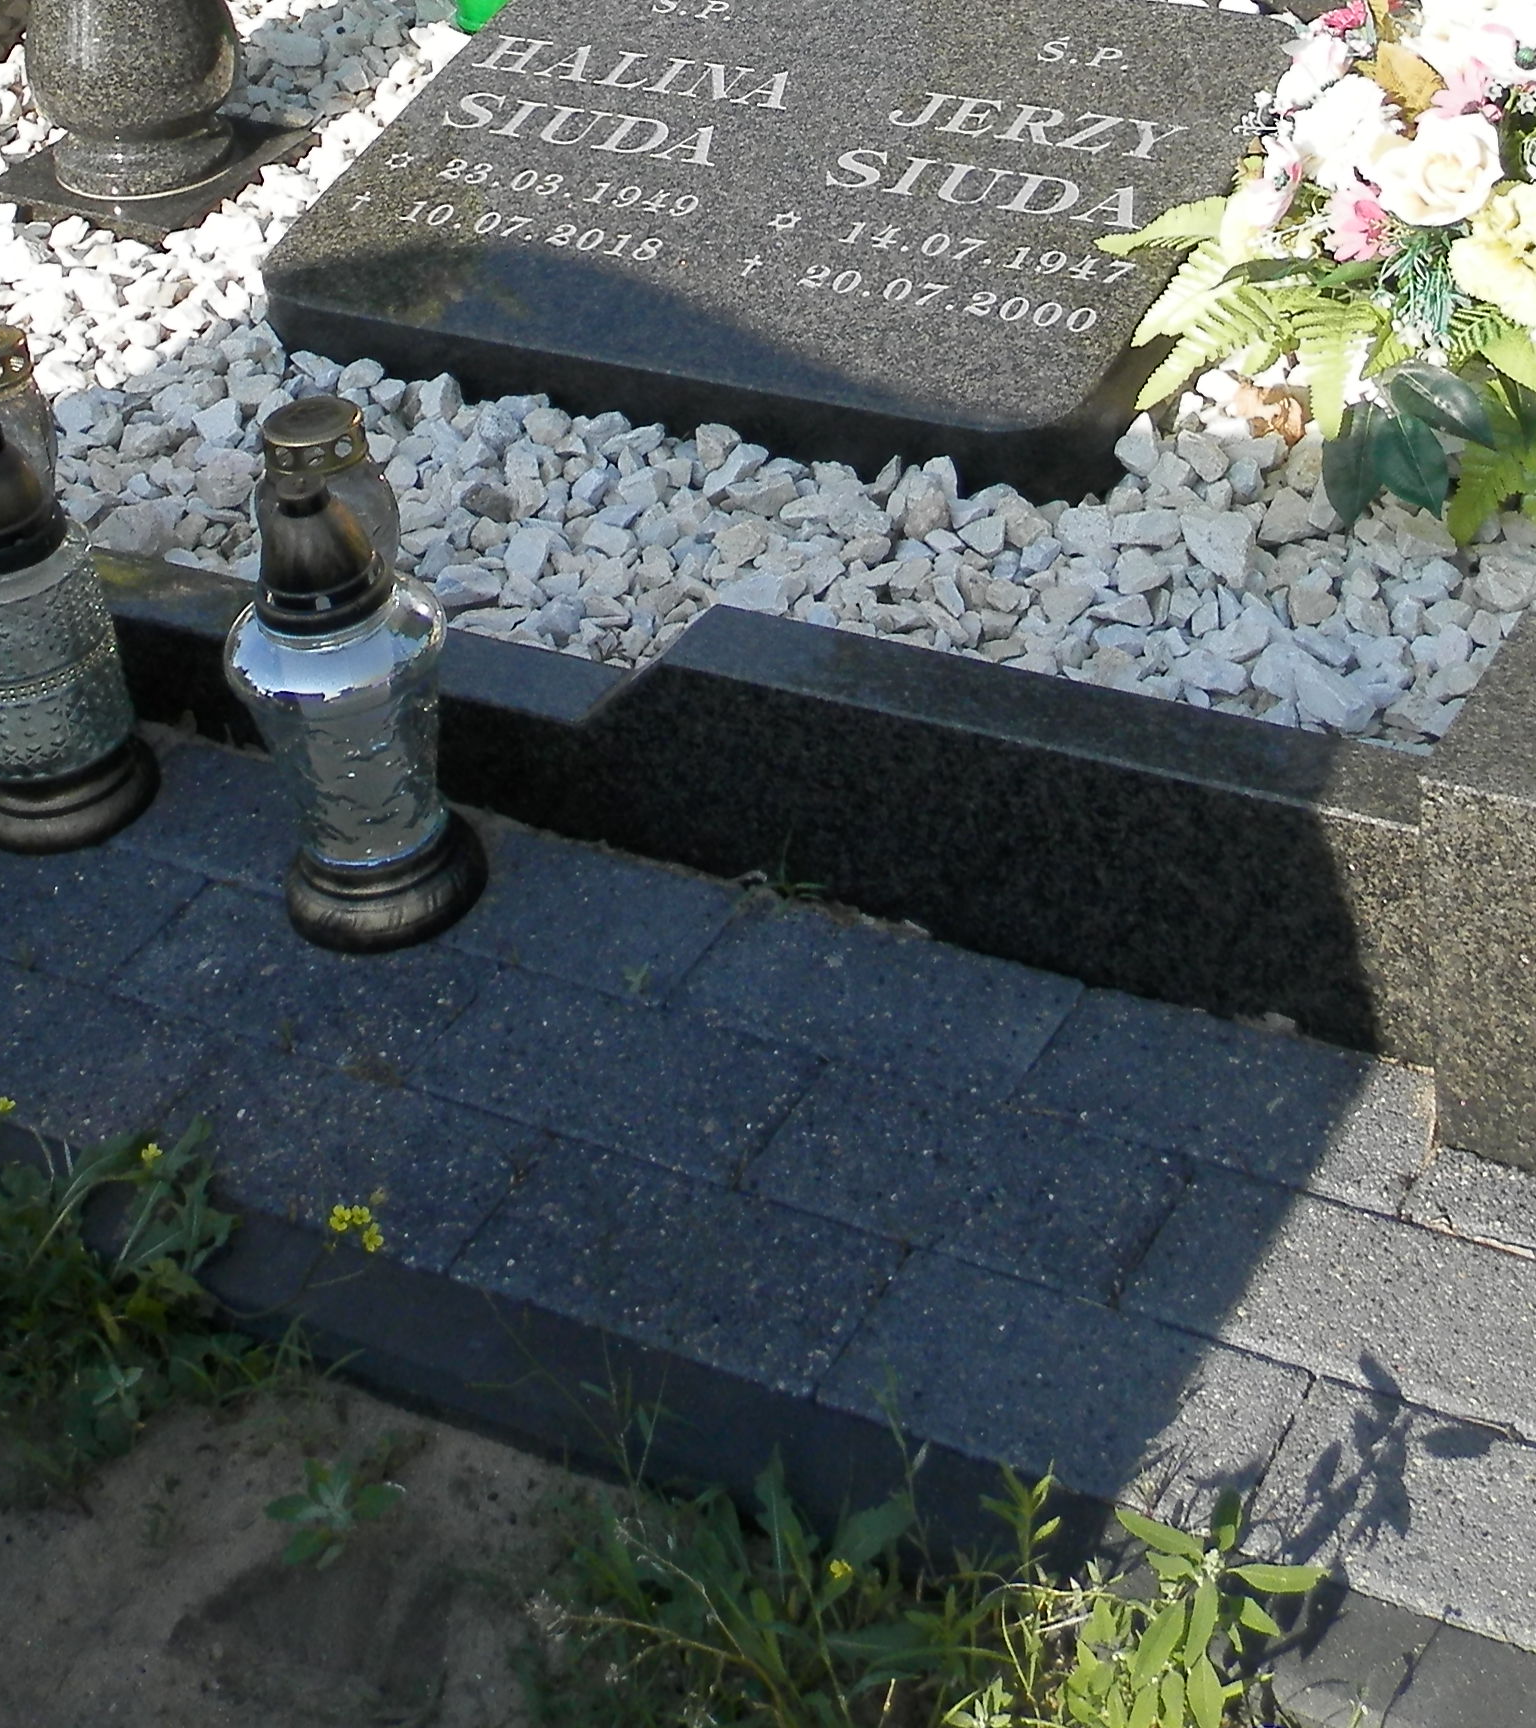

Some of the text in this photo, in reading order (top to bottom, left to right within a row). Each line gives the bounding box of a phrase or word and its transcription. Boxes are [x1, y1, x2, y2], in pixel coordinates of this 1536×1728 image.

[471, 34, 789, 111] HALINA
[442, 92, 716, 167] SIUDA
[888, 92, 1190, 160] JERZY
[437, 158, 700, 218] 23.03.1949
[826, 148, 1142, 230] SIUDA
[399, 200, 664, 262] 10.07.2018
[838, 221, 1137, 285] 14.07.1947
[796, 263, 1097, 333] 20.07.2000
